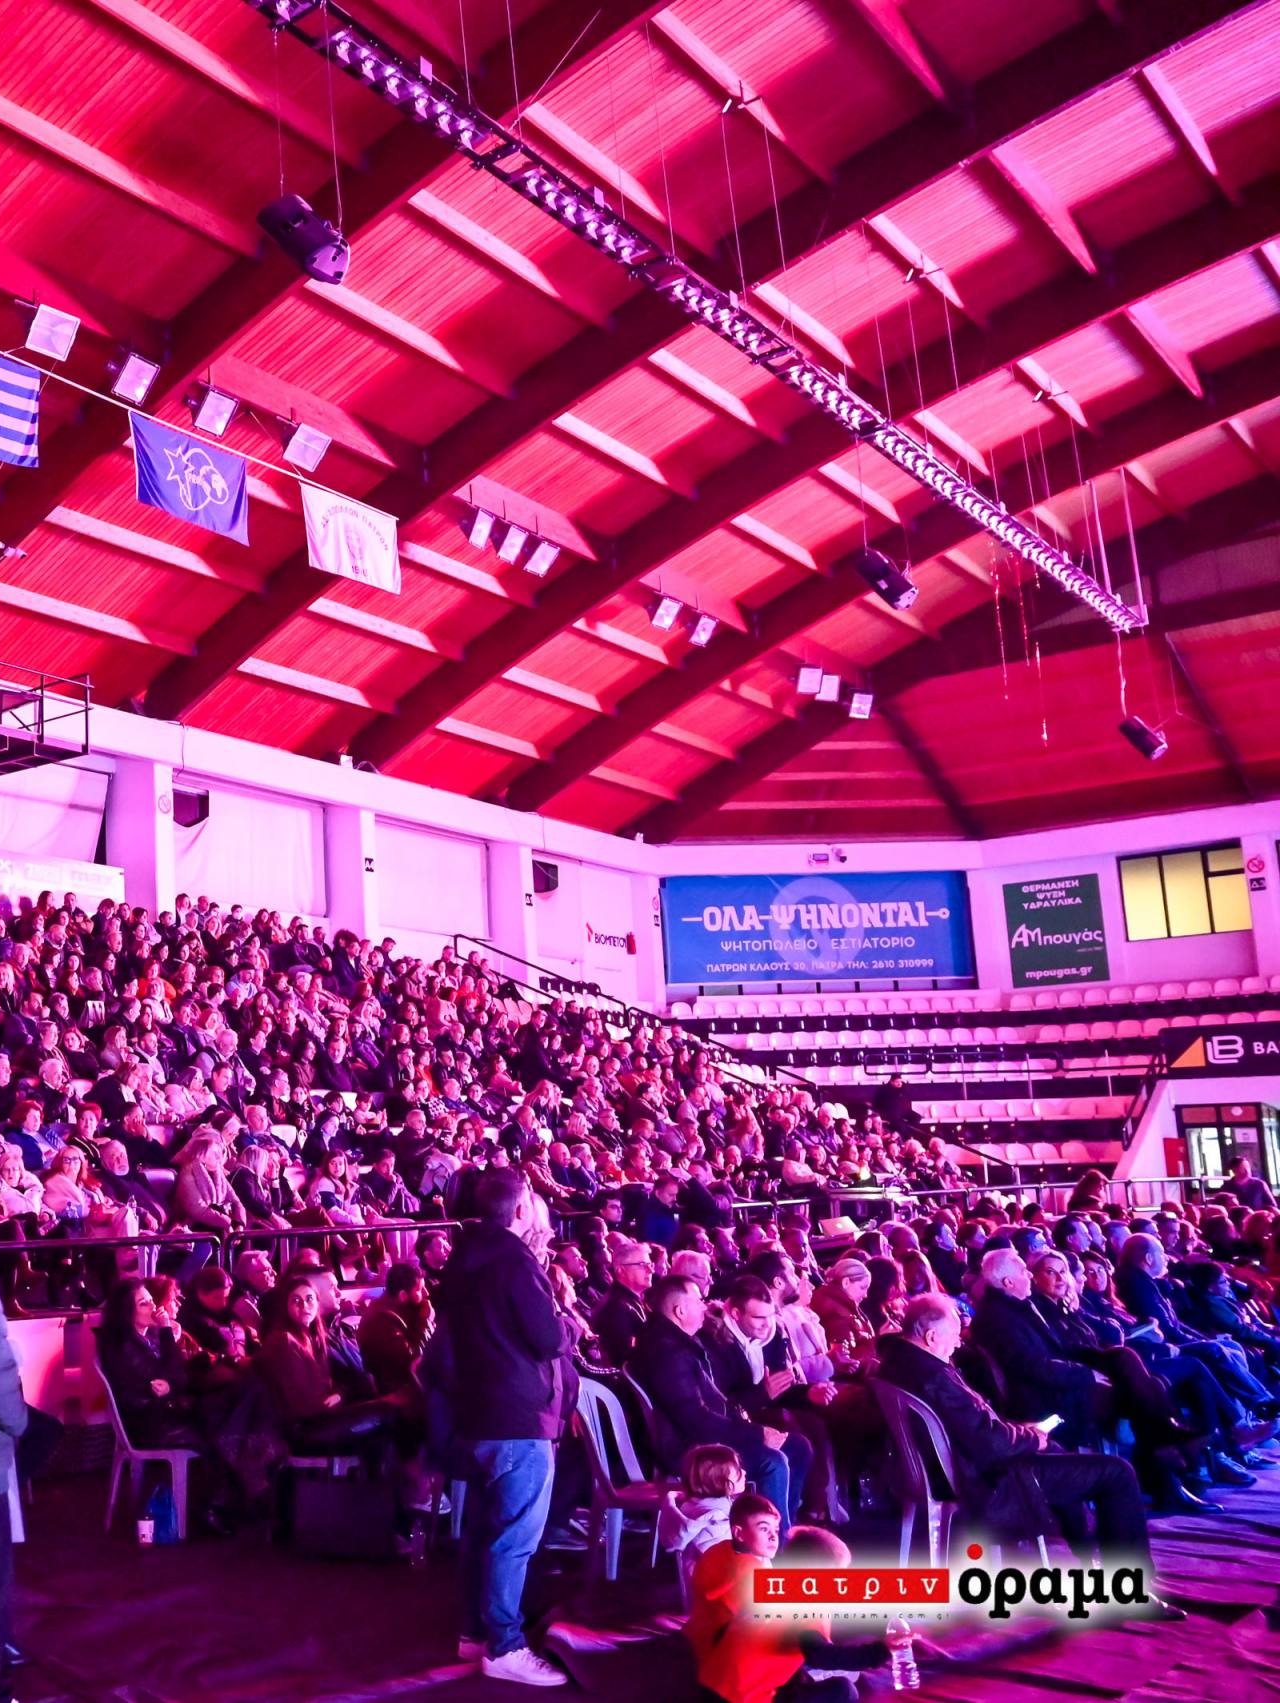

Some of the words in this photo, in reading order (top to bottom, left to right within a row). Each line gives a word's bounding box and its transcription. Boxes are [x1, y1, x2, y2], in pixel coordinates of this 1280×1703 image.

[1022, 880, 1080, 893] ΘΕΡΜΑΝΣΗ
[1022, 897, 1083, 910] ΥΔΡΑΥΛΙΚΑ
[703, 905, 764, 931] ΟΛΑ
[770, 901, 929, 930] ΨΗΝΟΝΤΑΙ
[720, 938, 818, 952] ΨΗΤΟΠΩΛΕΙΟ
[831, 936, 916, 950] ΕΣΤΙΑΤΟΡΙΟ
[706, 963, 747, 973] ΠΑΤΡΩΝ
[750, 962, 791, 972] ΚΛΑΟΥΣ
[871, 959, 895, 969] 2610
[1025, 966, 1093, 980] mpougas.gr
